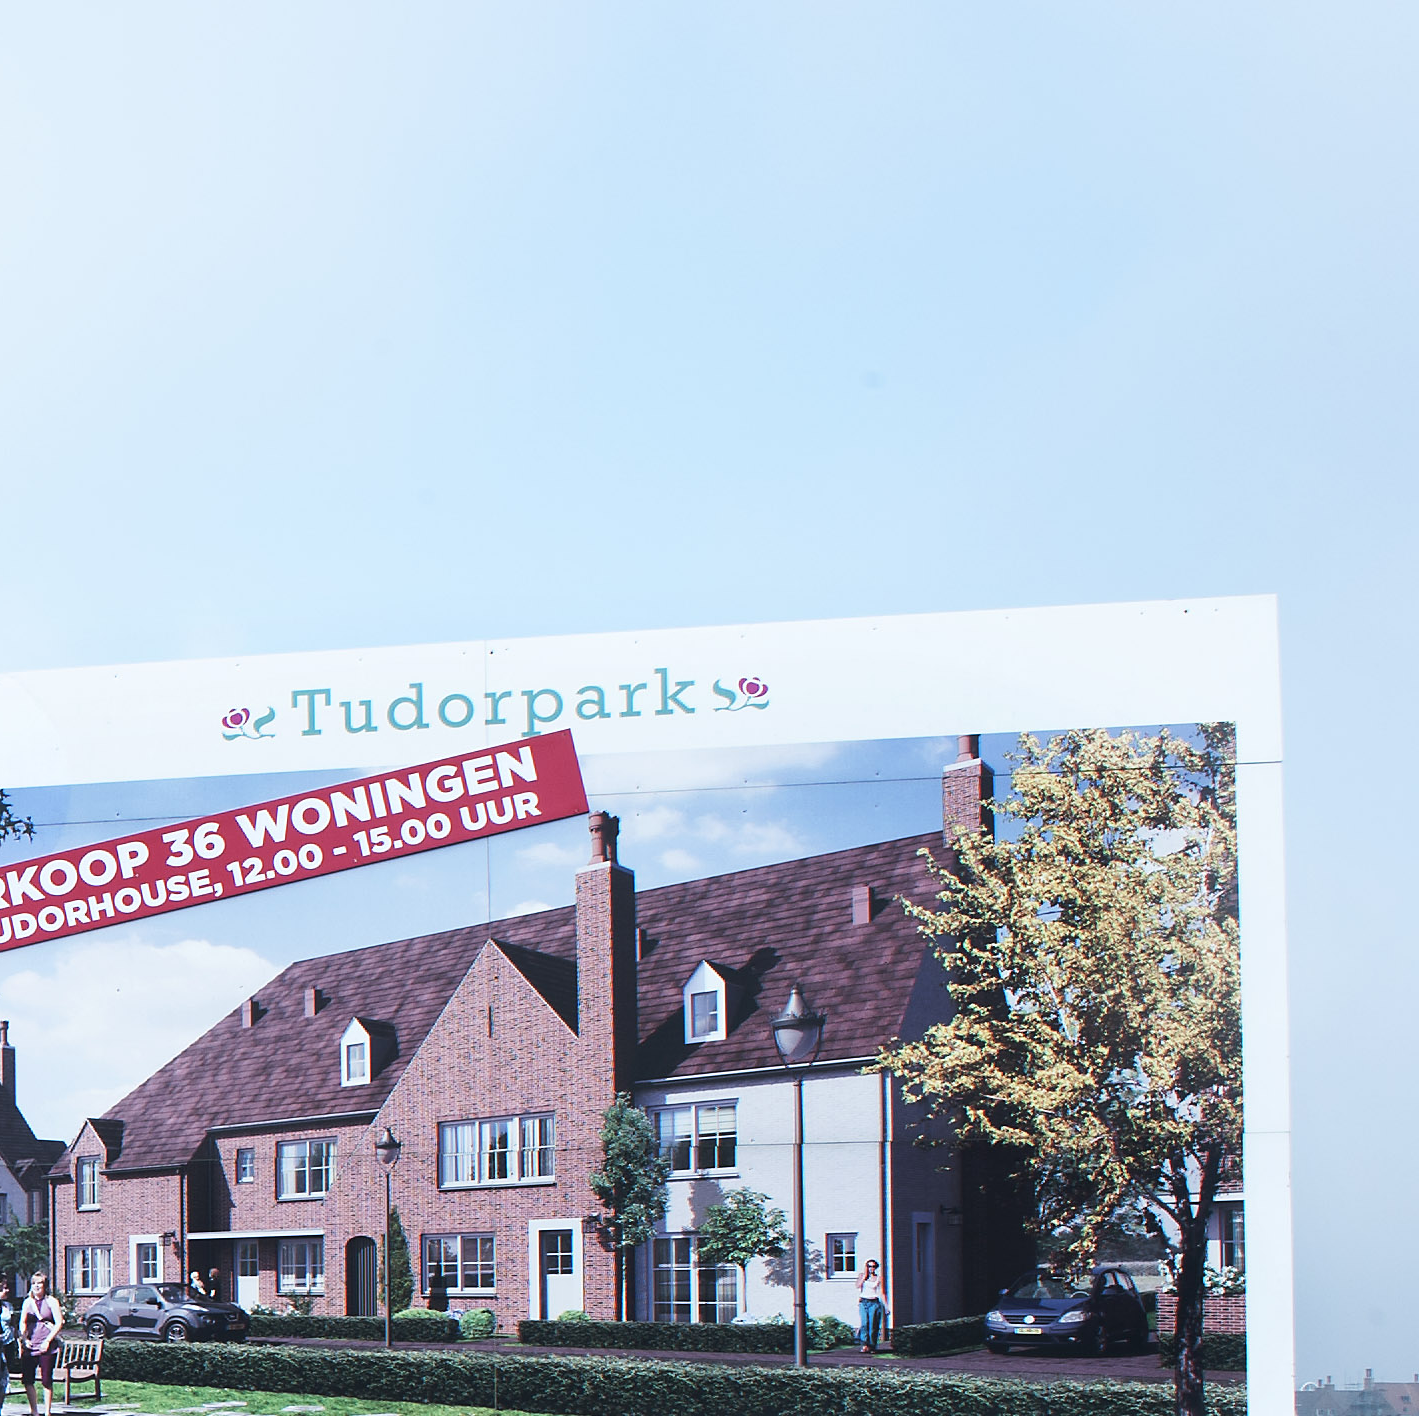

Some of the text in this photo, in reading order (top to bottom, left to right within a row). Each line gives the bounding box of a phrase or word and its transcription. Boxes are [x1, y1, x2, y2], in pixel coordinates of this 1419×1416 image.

[291, 668, 695, 738] Tudorpark
[162, 821, 226, 867] 36
[234, 745, 538, 848] WONINGEN
[226, 843, 323, 887] 12.00
[332, 845, 348, 857] -
[352, 812, 452, 857] 15.00
[459, 791, 542, 831] UUR
